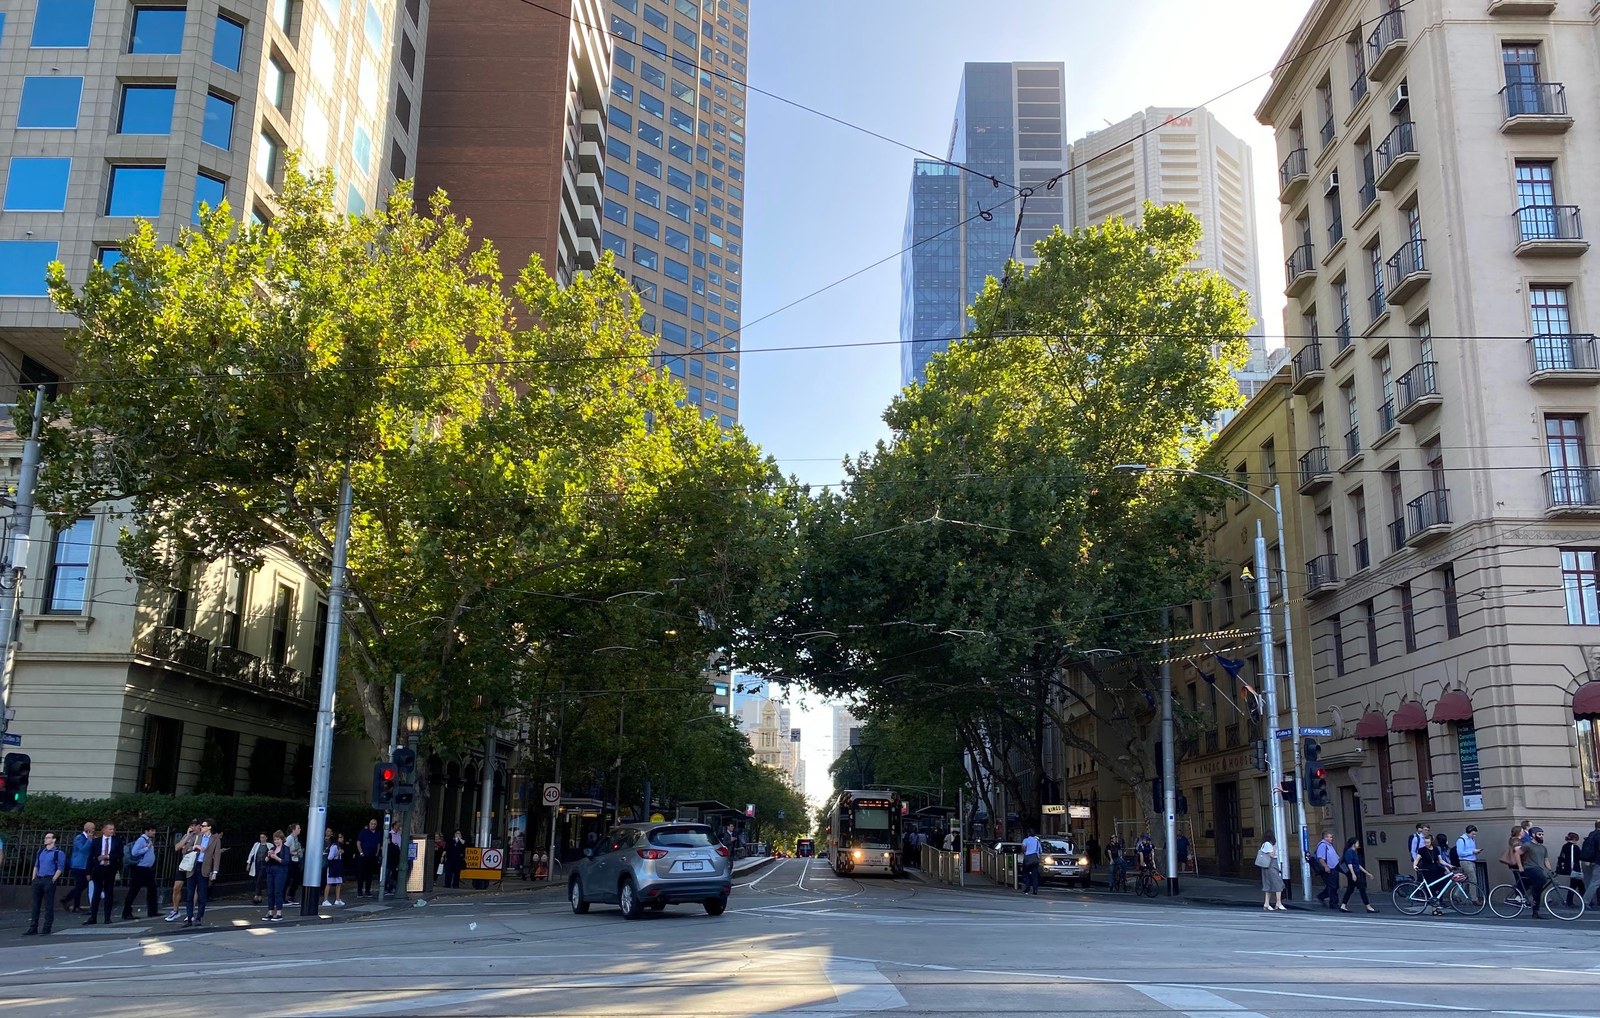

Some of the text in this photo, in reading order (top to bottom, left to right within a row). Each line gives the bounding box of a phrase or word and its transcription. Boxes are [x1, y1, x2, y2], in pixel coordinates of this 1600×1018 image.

[1200, 761, 1220, 774] ANZAC
[1229, 755, 1252, 769] HOUSE
[486, 854, 499, 863] 40
